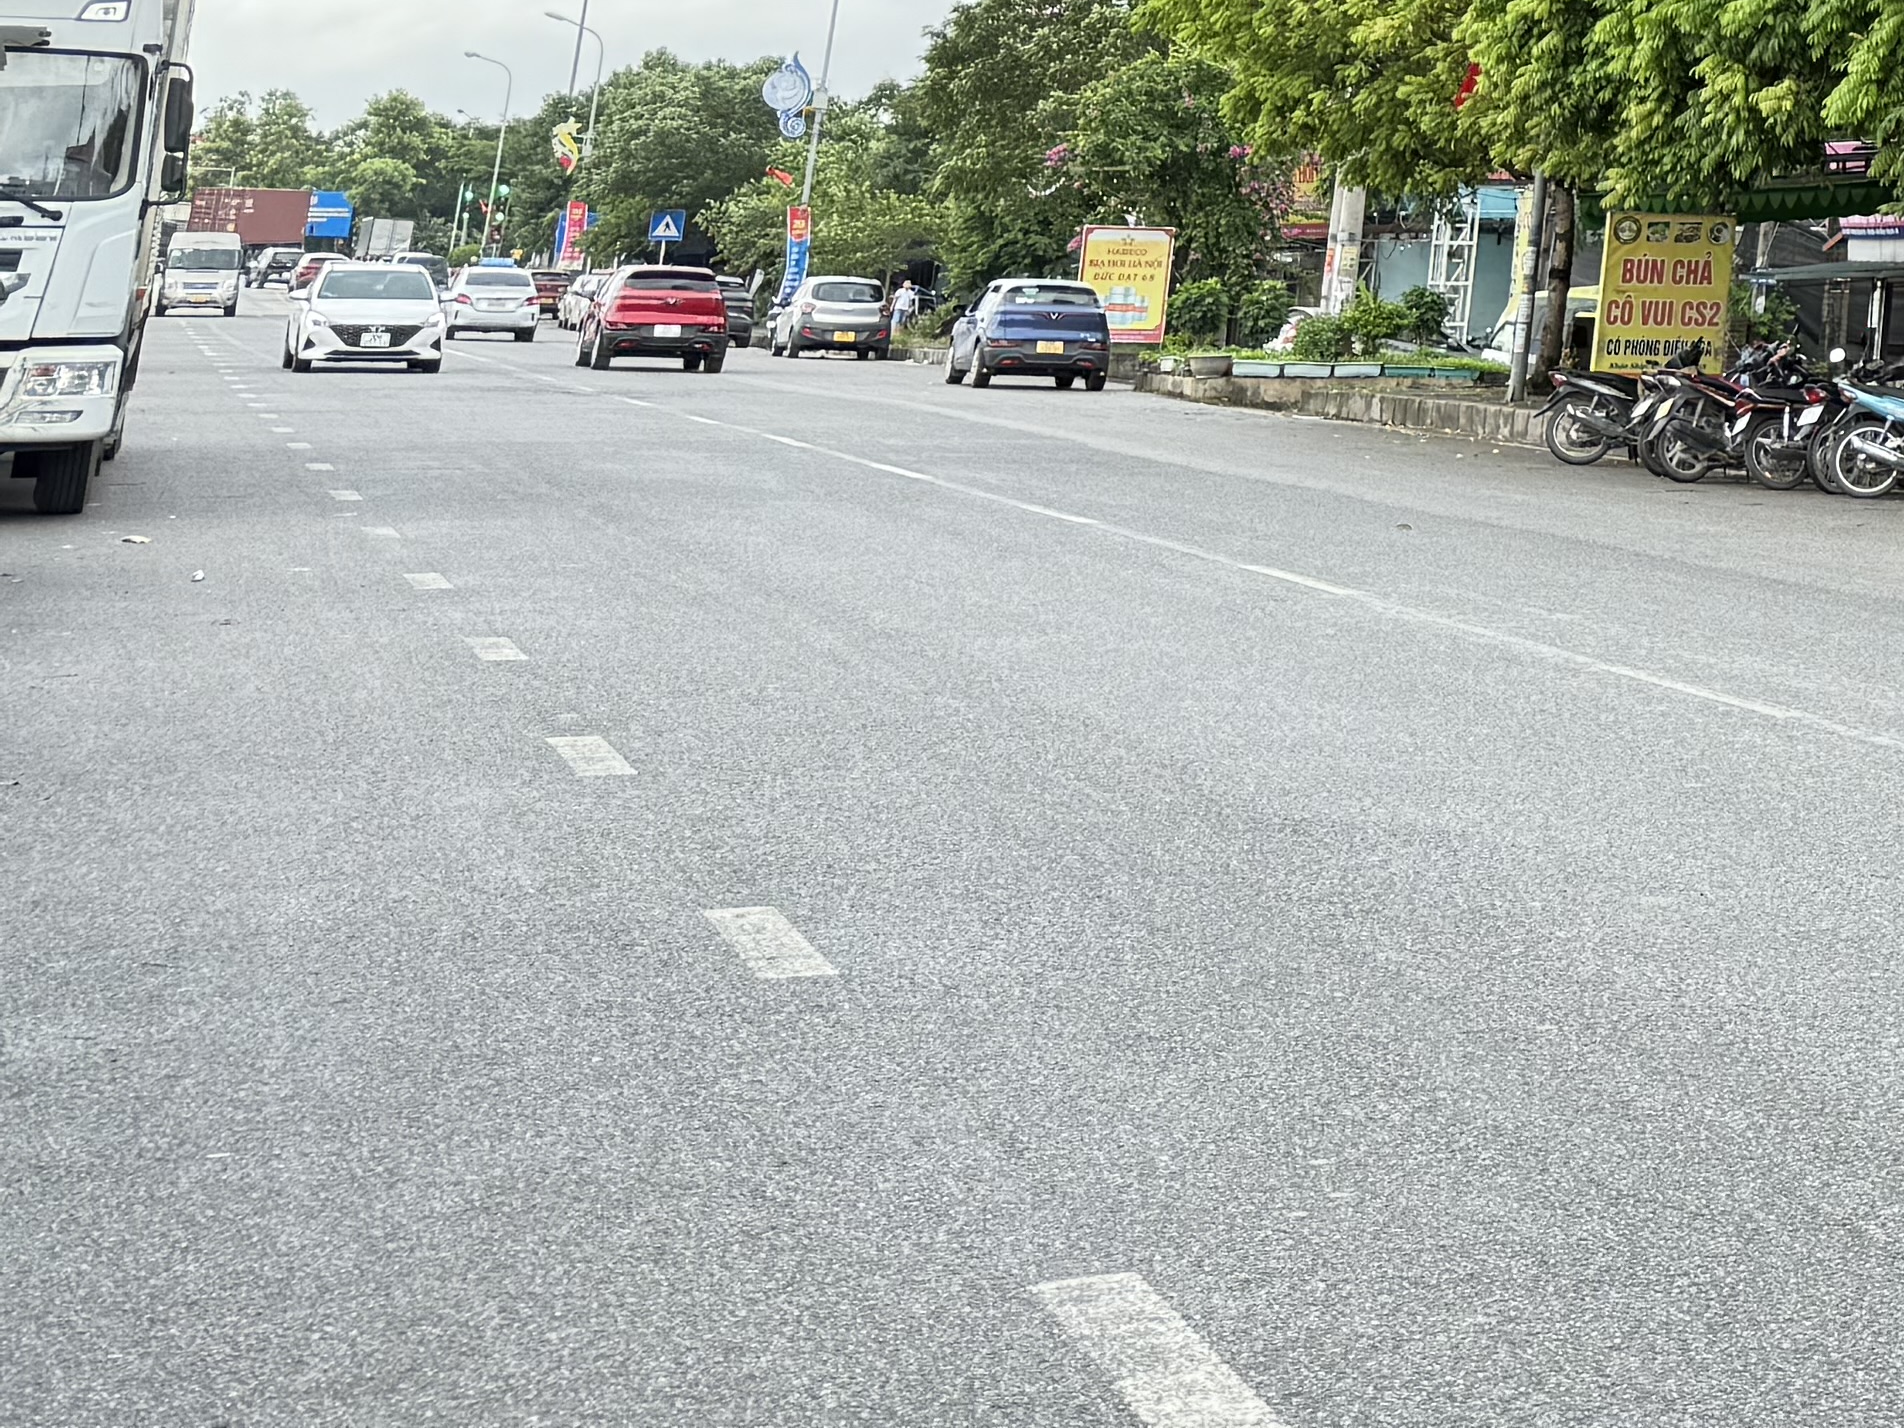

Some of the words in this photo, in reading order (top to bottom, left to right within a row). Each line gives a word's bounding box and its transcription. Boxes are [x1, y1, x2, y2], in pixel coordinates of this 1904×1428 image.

[1621, 253, 1666, 285] BÚN
[1671, 251, 1713, 286] CHẢ
[1605, 294, 1635, 326] CÔ
[1641, 300, 1674, 326] VUI
[1680, 300, 1722, 327] CS2
[1607, 336, 1620, 356] CÓ
[1624, 336, 1660, 356] PHÒNG
